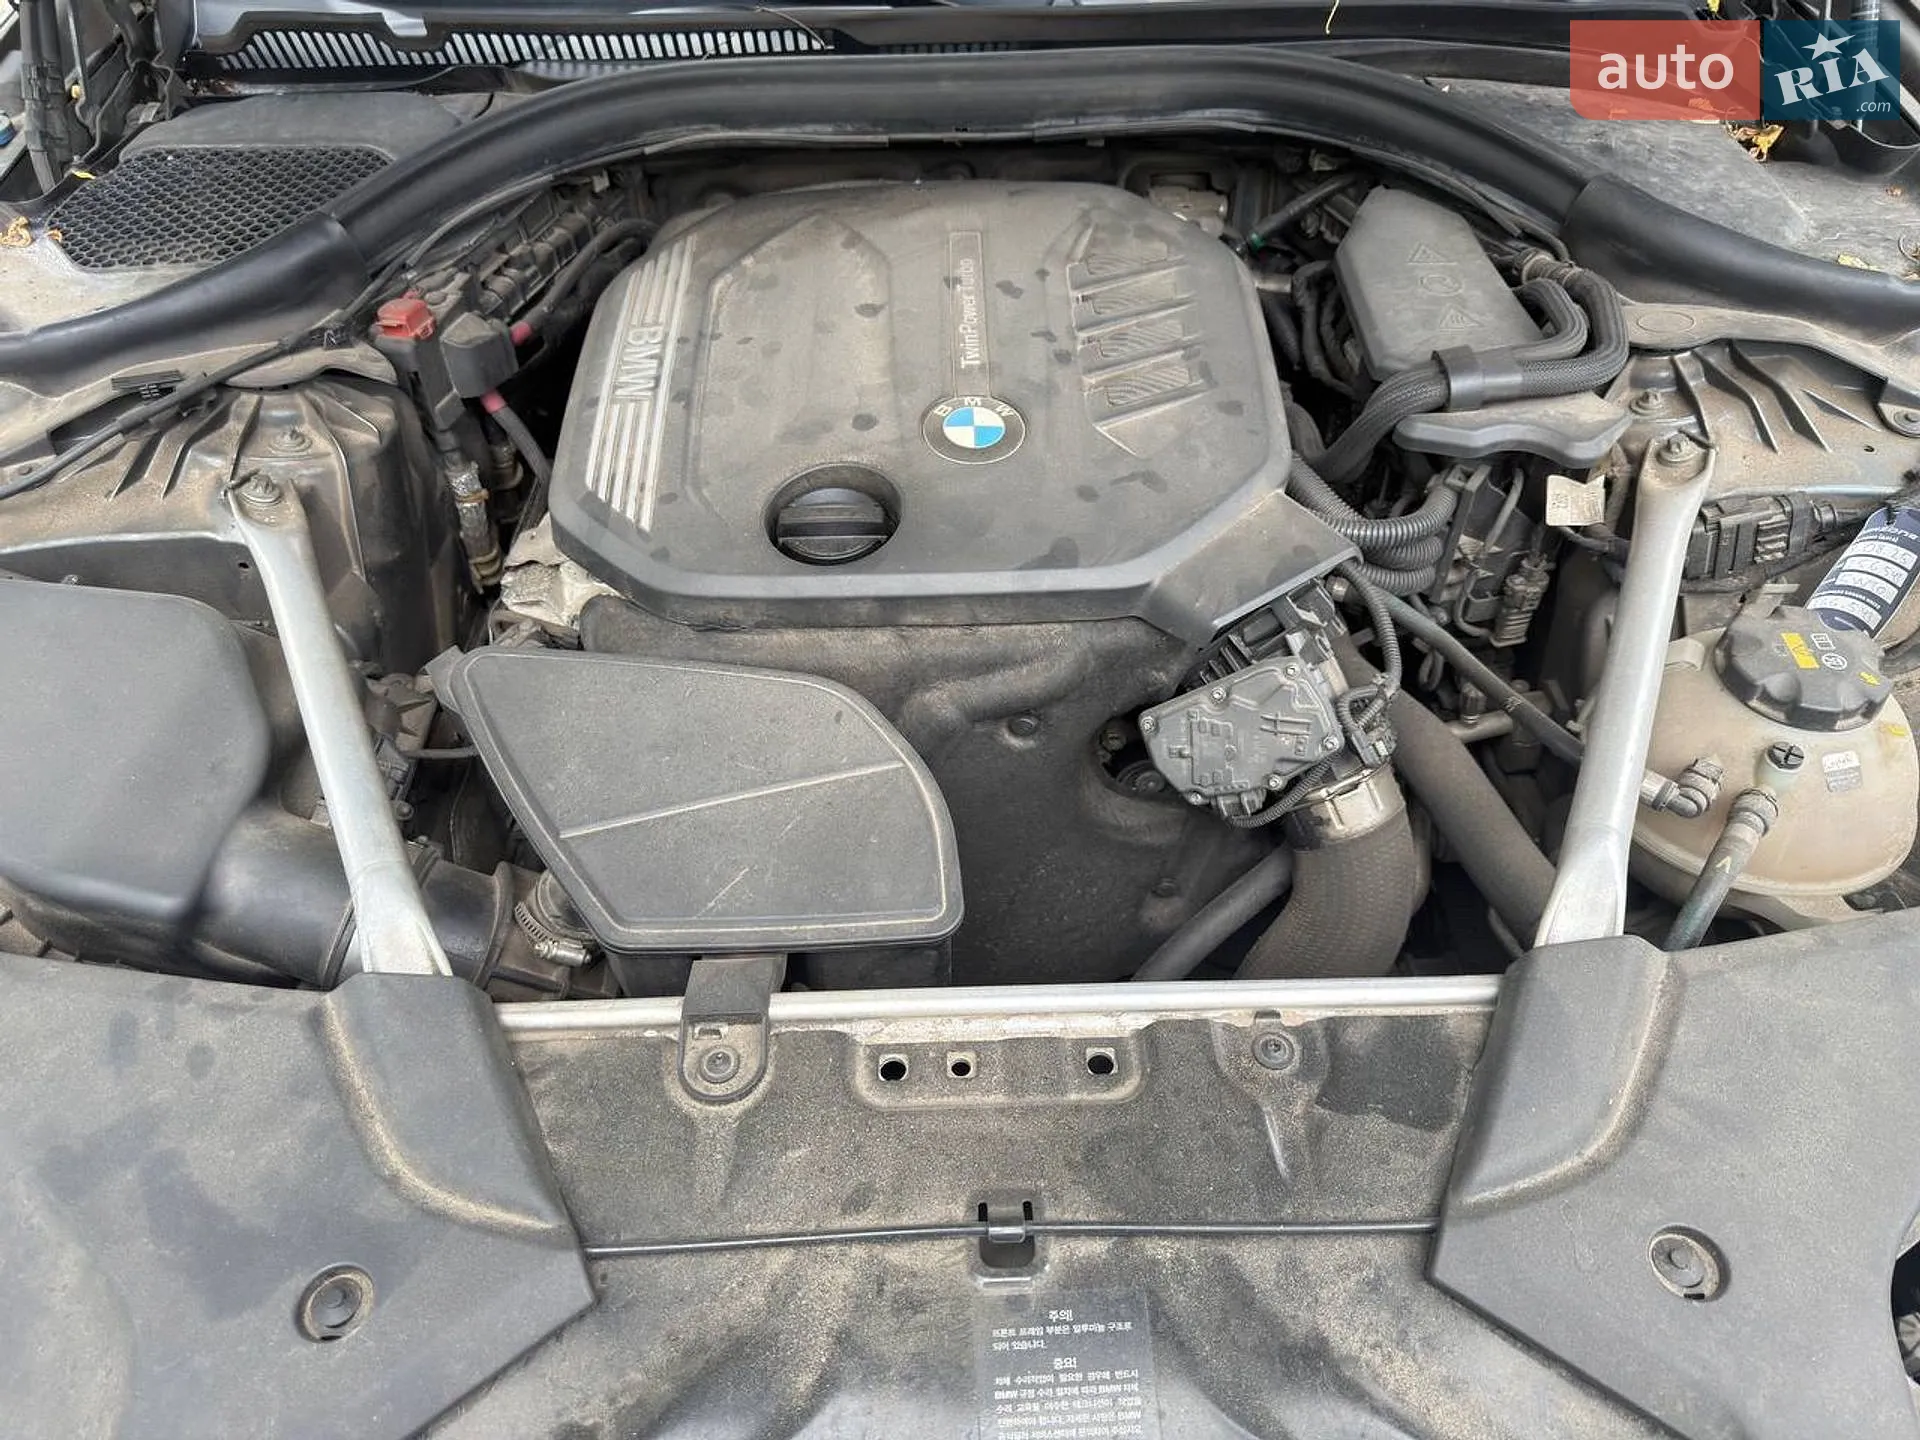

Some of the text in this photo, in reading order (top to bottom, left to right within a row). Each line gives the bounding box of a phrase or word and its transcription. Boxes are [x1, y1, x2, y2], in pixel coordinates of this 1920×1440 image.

[956, 257, 980, 369] TwinPower Turbo
[613, 325, 664, 398] BMW
[933, 396, 1015, 418] BMW
[1048, 1309, 1073, 1322] 주의!
[1053, 1357, 1077, 1369] 중요!
[1099, 1384, 1121, 1393] BMW
